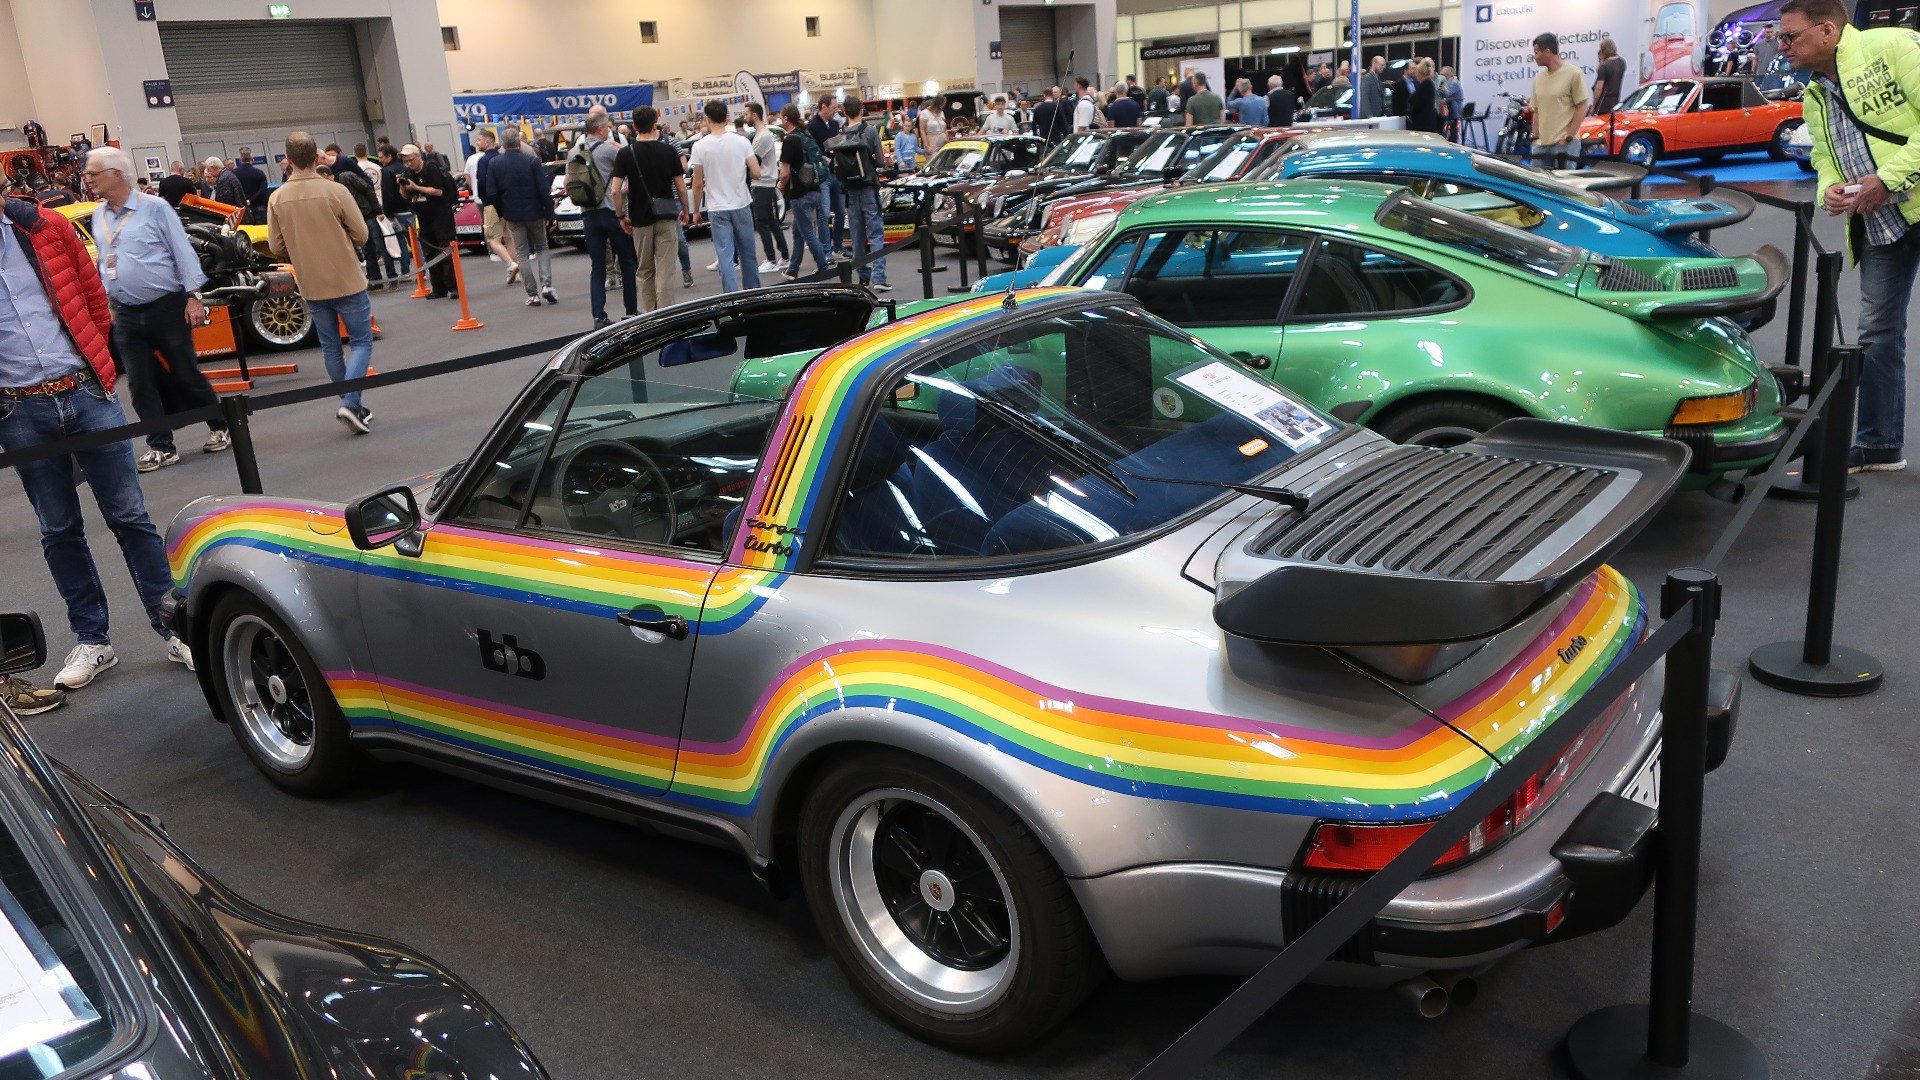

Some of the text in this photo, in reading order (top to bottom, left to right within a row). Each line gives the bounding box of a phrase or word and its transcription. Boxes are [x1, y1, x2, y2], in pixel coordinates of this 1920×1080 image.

[1496, 5, 1533, 15] catawiki
[1144, 46, 1187, 57] RESTAURANT
[1476, 38, 1532, 51] Discover
[1475, 56, 1502, 67] cars
[1506, 54, 1523, 64] on
[759, 75, 798, 85] SUBARU
[820, 72, 855, 81] SUBARU
[1475, 66, 1525, 81] selected
[1846, 66, 1881, 89] CAMP
[692, 80, 733, 89] SUBARU
[1857, 71, 1892, 95] DAVID
[546, 93, 618, 110] VOLVO
[1862, 91, 1894, 116] AIR
[745, 518, 806, 535] targa
[743, 535, 793, 557] turbo
[1557, 635, 1587, 664] turbo
